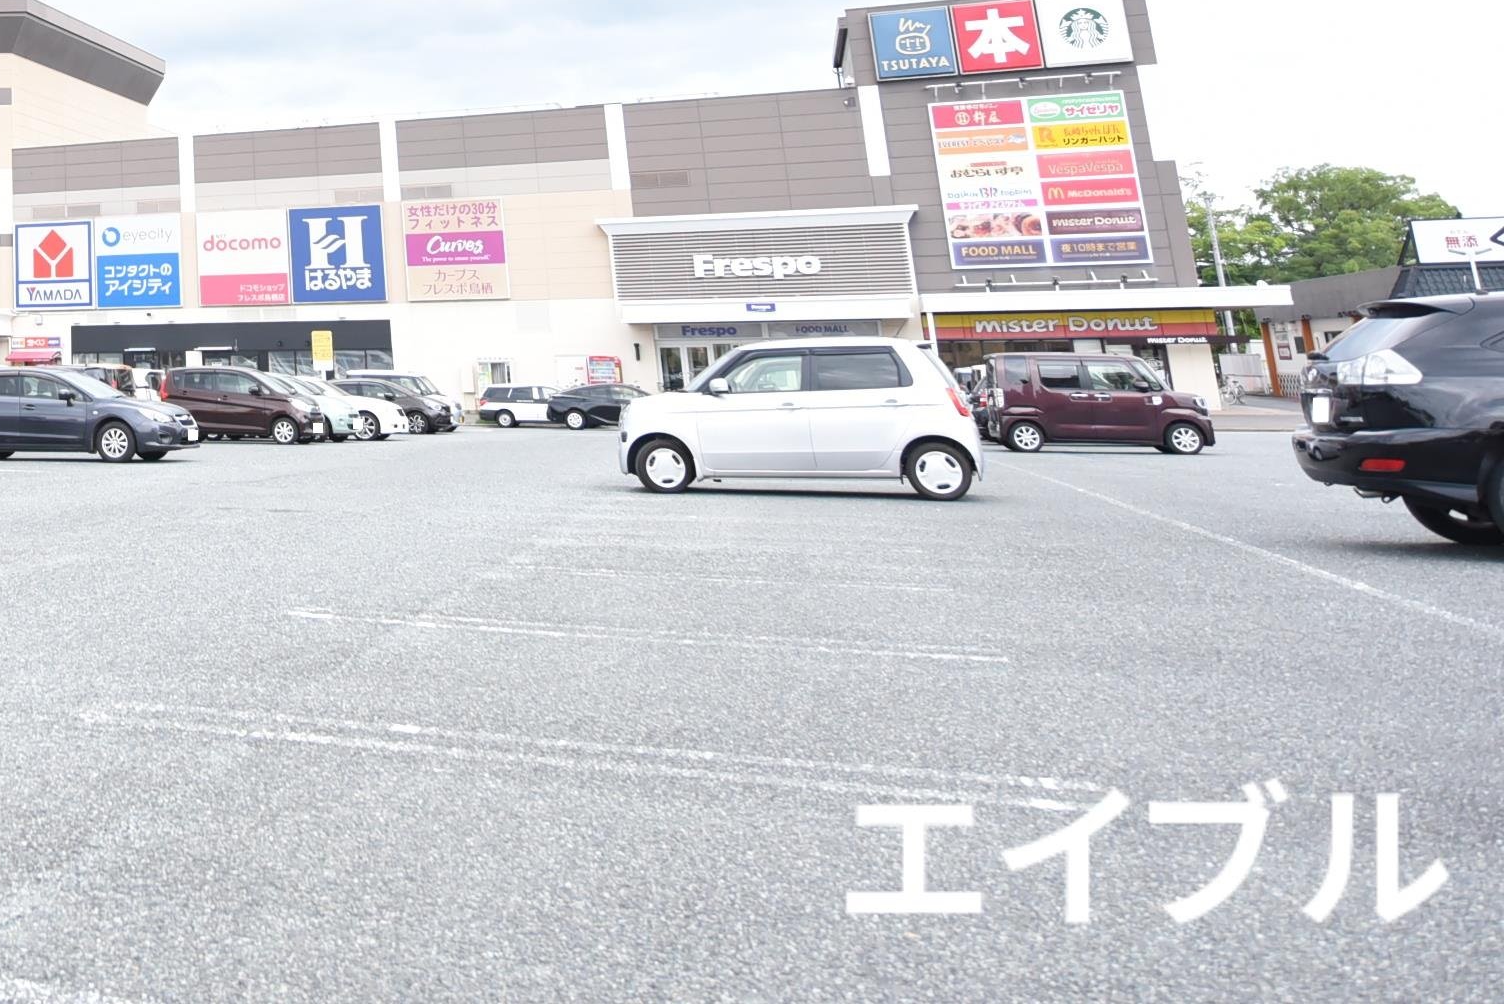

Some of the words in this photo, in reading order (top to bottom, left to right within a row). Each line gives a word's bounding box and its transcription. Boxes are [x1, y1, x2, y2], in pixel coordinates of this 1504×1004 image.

[964, 8, 1031, 63] 本
[881, 56, 950, 71] TSUTAYA
[1064, 104, 1119, 116] サイゼリヤ
[1063, 134, 1124, 146] リンガーハット
[1067, 188, 1132, 197] McDonald's
[407, 202, 497, 218] 女性だけの30分
[408, 215, 499, 230] フィットネス
[1094, 215, 1137, 226] Donut
[122, 228, 173, 244] eyecity
[203, 234, 282, 252] docomo
[426, 235, 484, 255] Curves
[962, 247, 998, 257] FOOD
[1001, 244, 1038, 255] MALL
[104, 263, 172, 278] コンタクトの
[693, 254, 822, 280] Frespo
[304, 268, 372, 290] はるやま
[26, 287, 82, 301] YAMADA
[104, 279, 172, 296] アイシティ
[240, 283, 285, 293] ドコモショップ
[423, 282, 494, 295] フレスポ鳥栖
[681, 325, 737, 338] Frespo
[796, 326, 823, 334] FOOD
[824, 324, 849, 333] MALL
[975, 317, 1059, 334] mister
[1068, 315, 1158, 332] Donut
[1147, 336, 1177, 344] mister
[1177, 336, 1208, 344] Donut
